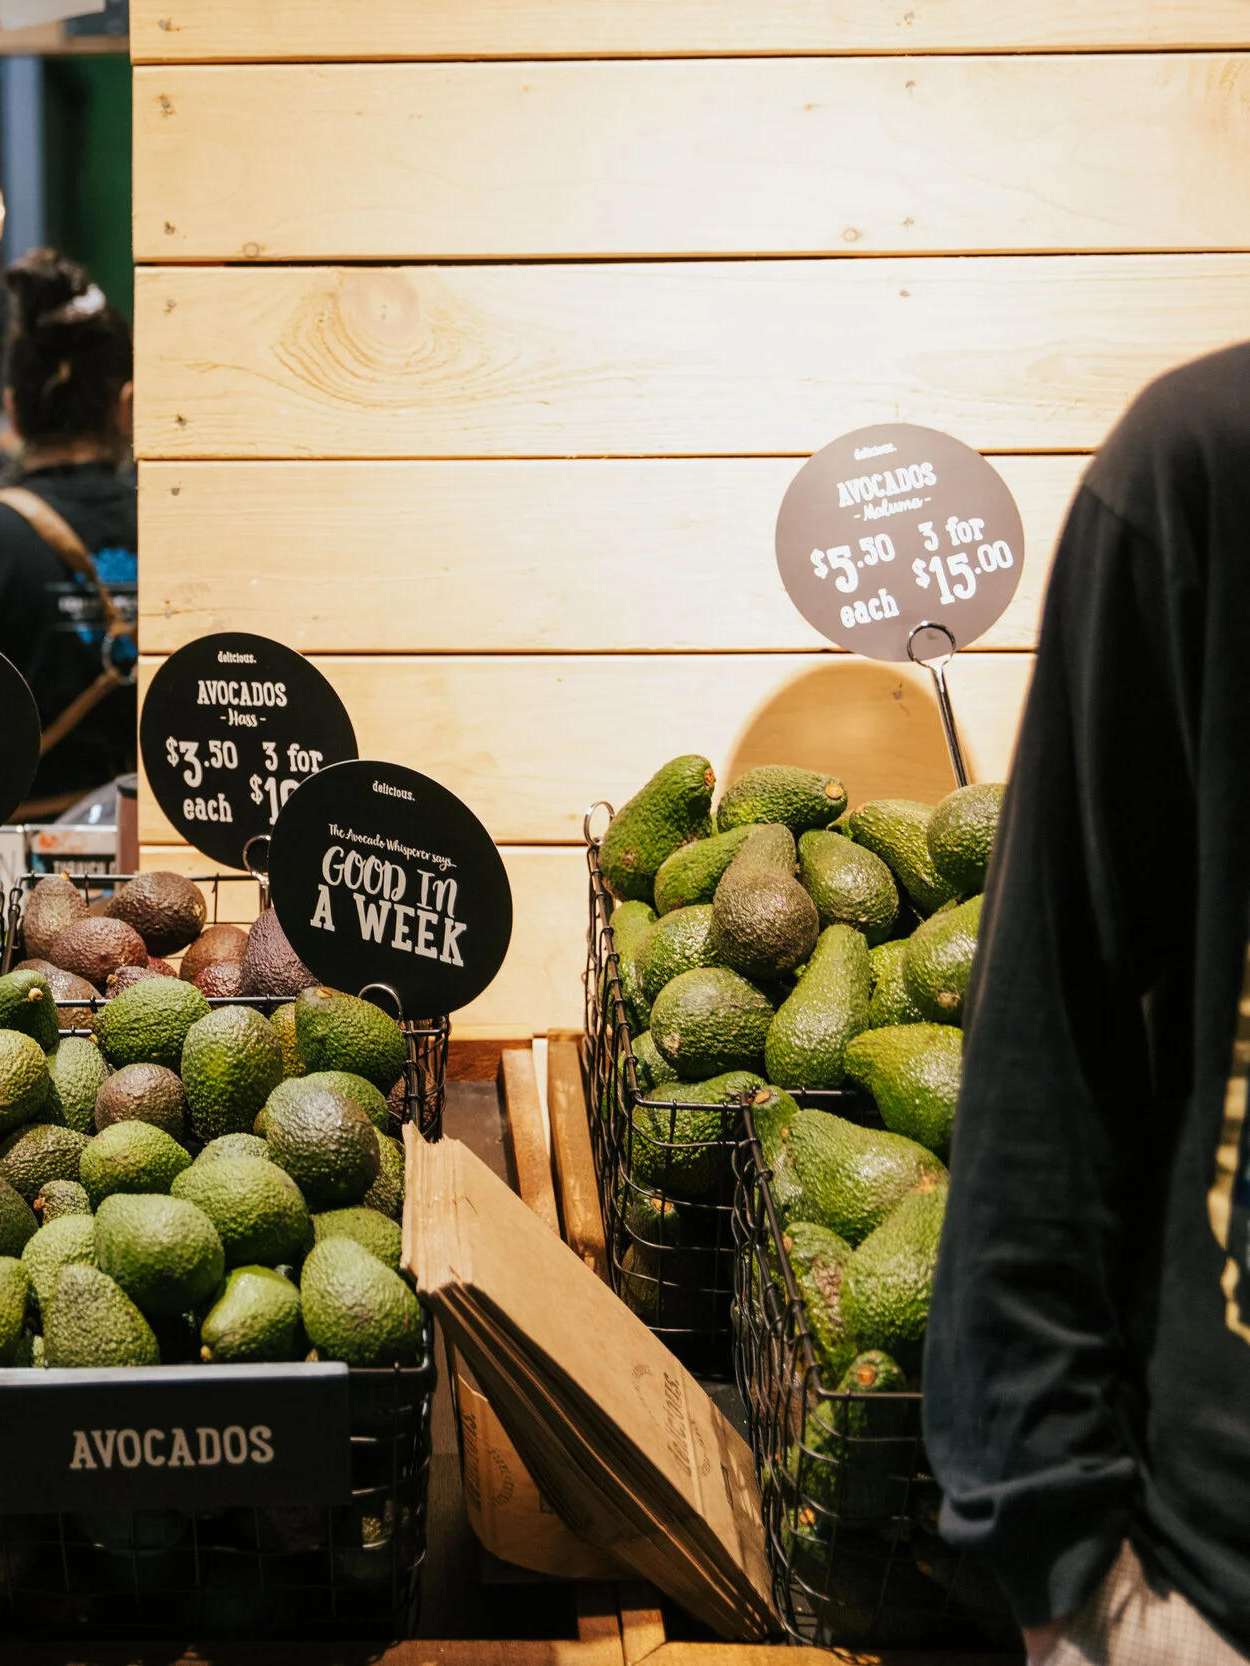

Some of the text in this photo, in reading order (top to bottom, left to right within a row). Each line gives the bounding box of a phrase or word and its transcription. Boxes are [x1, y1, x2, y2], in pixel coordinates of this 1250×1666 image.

[837, 462, 937, 508] AVOCADOS
[918, 516, 985, 551] 3 for
[810, 533, 1014, 605] $5.50 $15.00
[840, 588, 900, 628] each
[217, 651, 257, 664] delicious.
[197, 680, 288, 707] AVOCADOS
[166, 736, 323, 788] $3.50 3 for
[183, 793, 233, 823] each
[372, 780, 415, 801] delicious.
[328, 823, 345, 839] The
[345, 828, 386, 849] Avocado
[386, 838, 432, 860] Whisperer
[322, 846, 407, 902] GOOD
[310, 883, 467, 967] A WEEK
[69, 1425, 274, 1470] AVOCADOS
